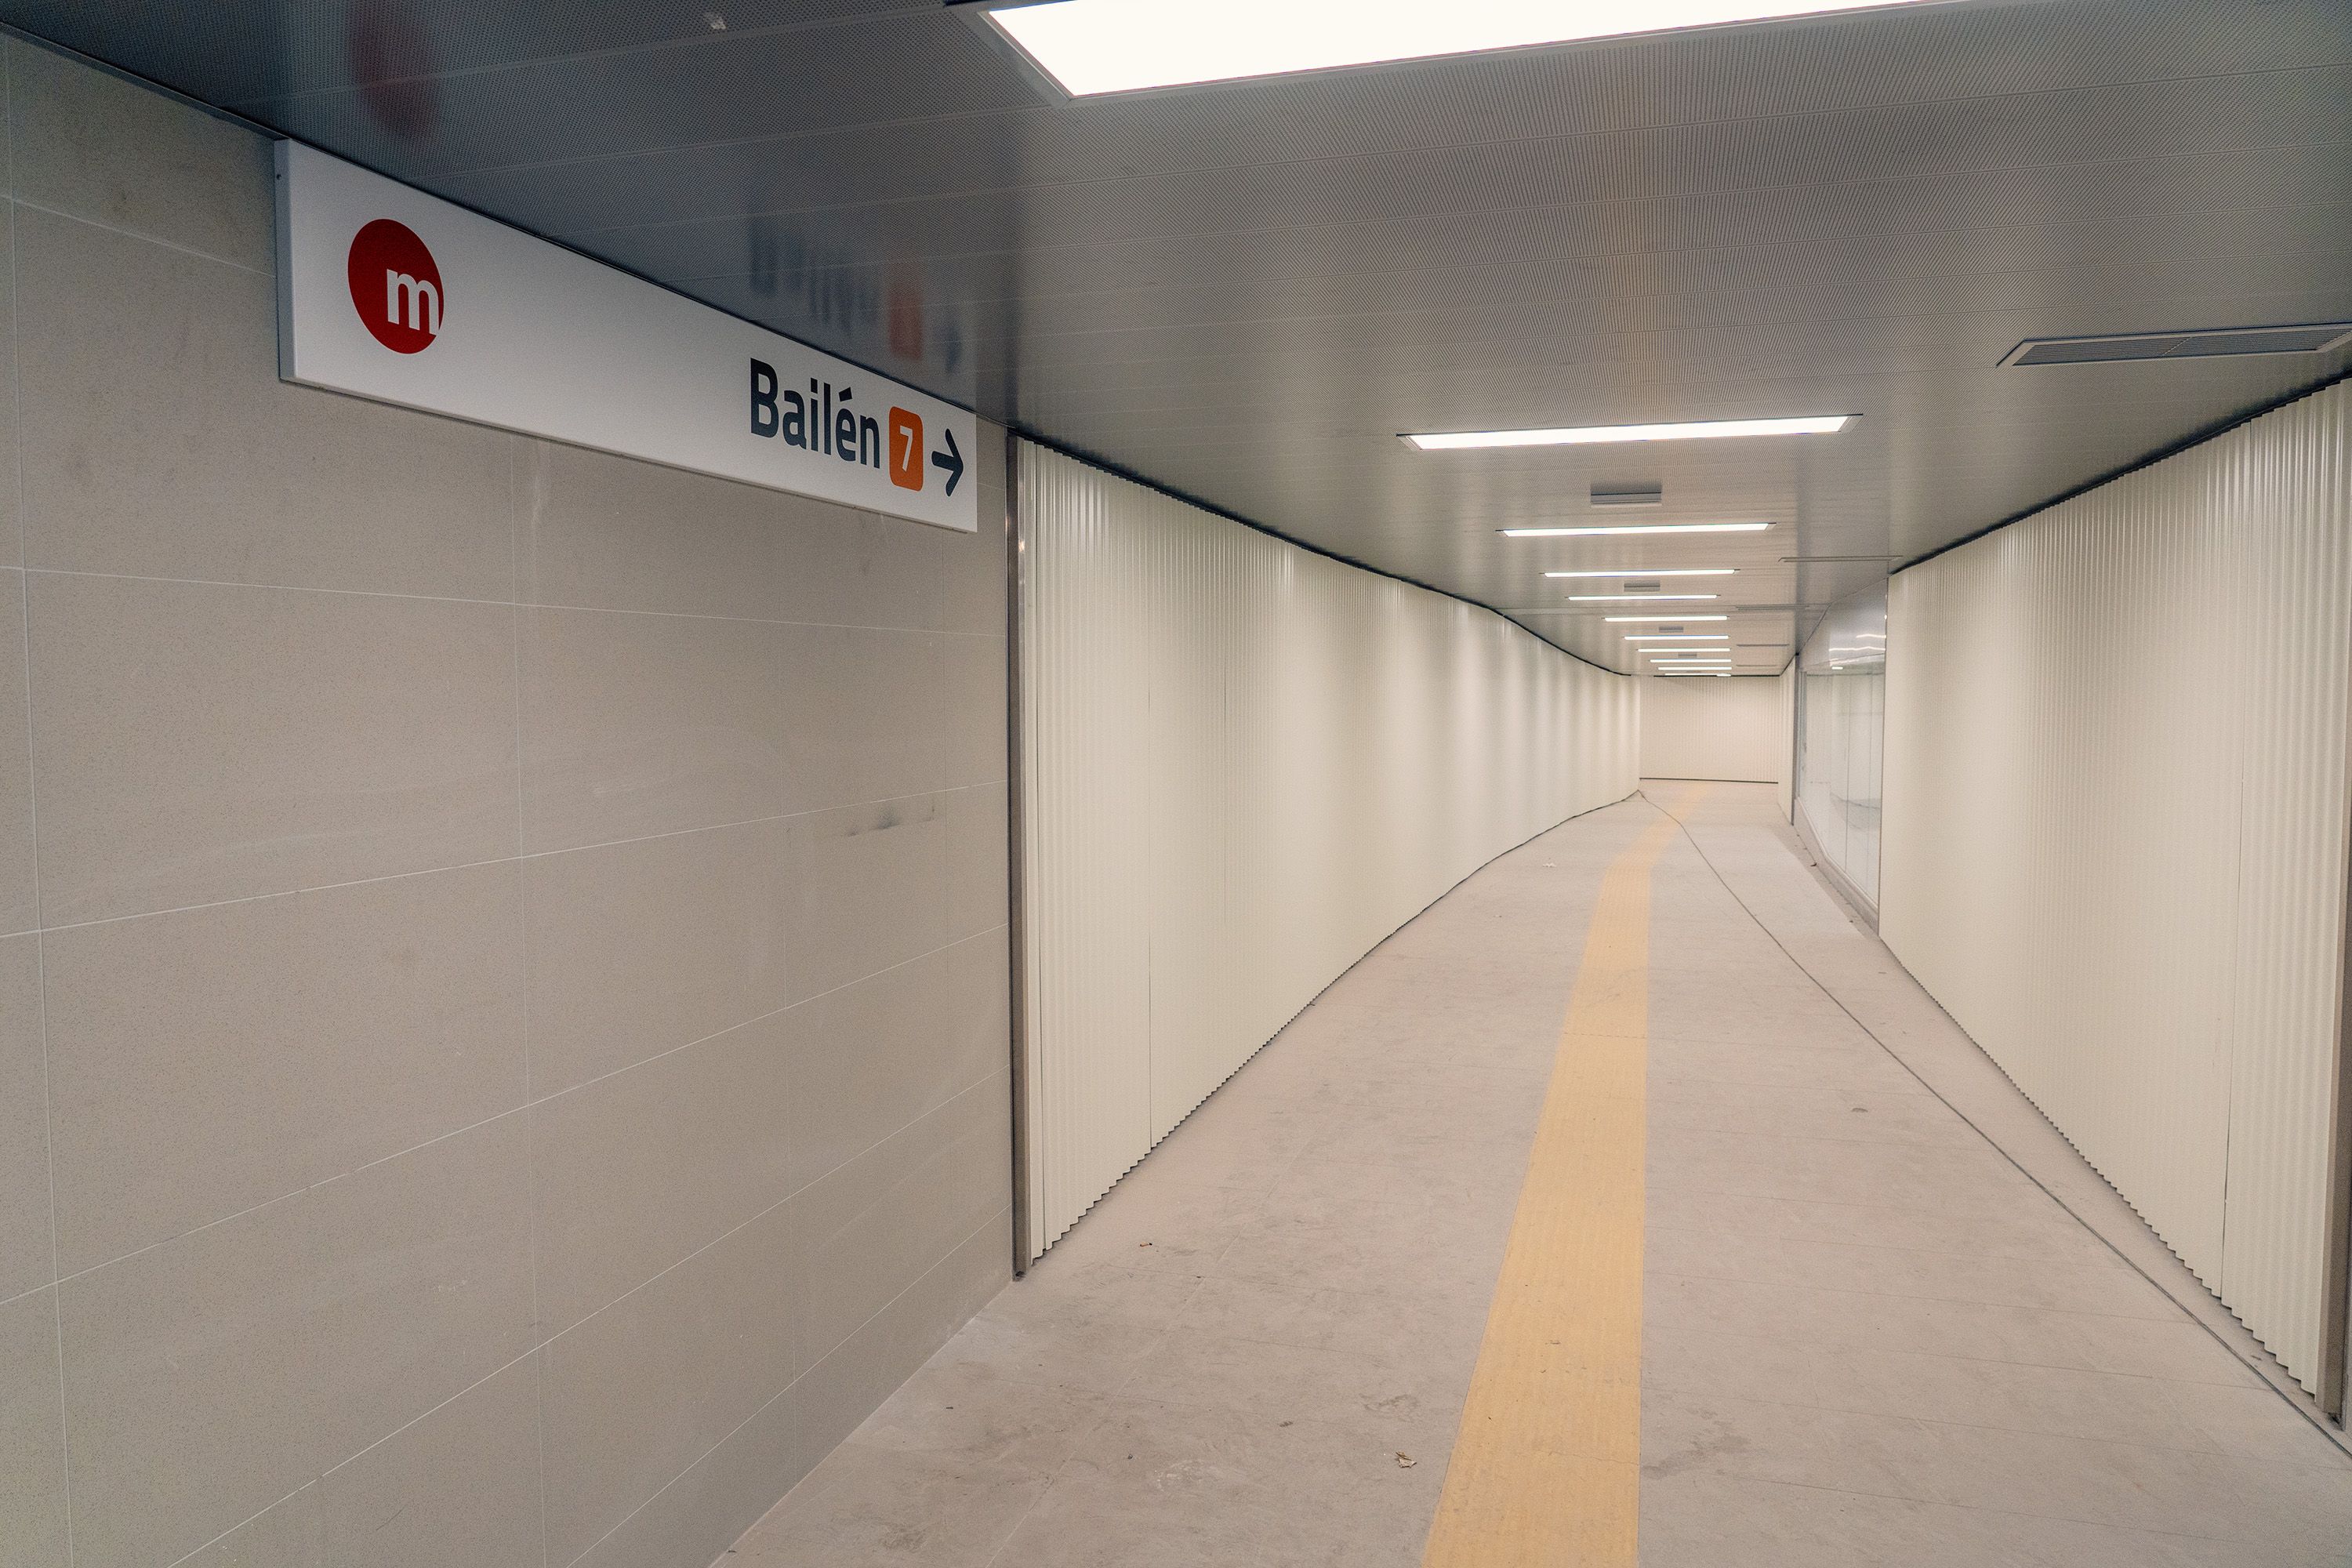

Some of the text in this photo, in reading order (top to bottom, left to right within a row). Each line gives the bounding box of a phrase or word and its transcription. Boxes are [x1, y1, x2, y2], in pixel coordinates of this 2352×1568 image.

[387, 268, 439, 336] m
[750, 358, 913, 472] Bailén 7
